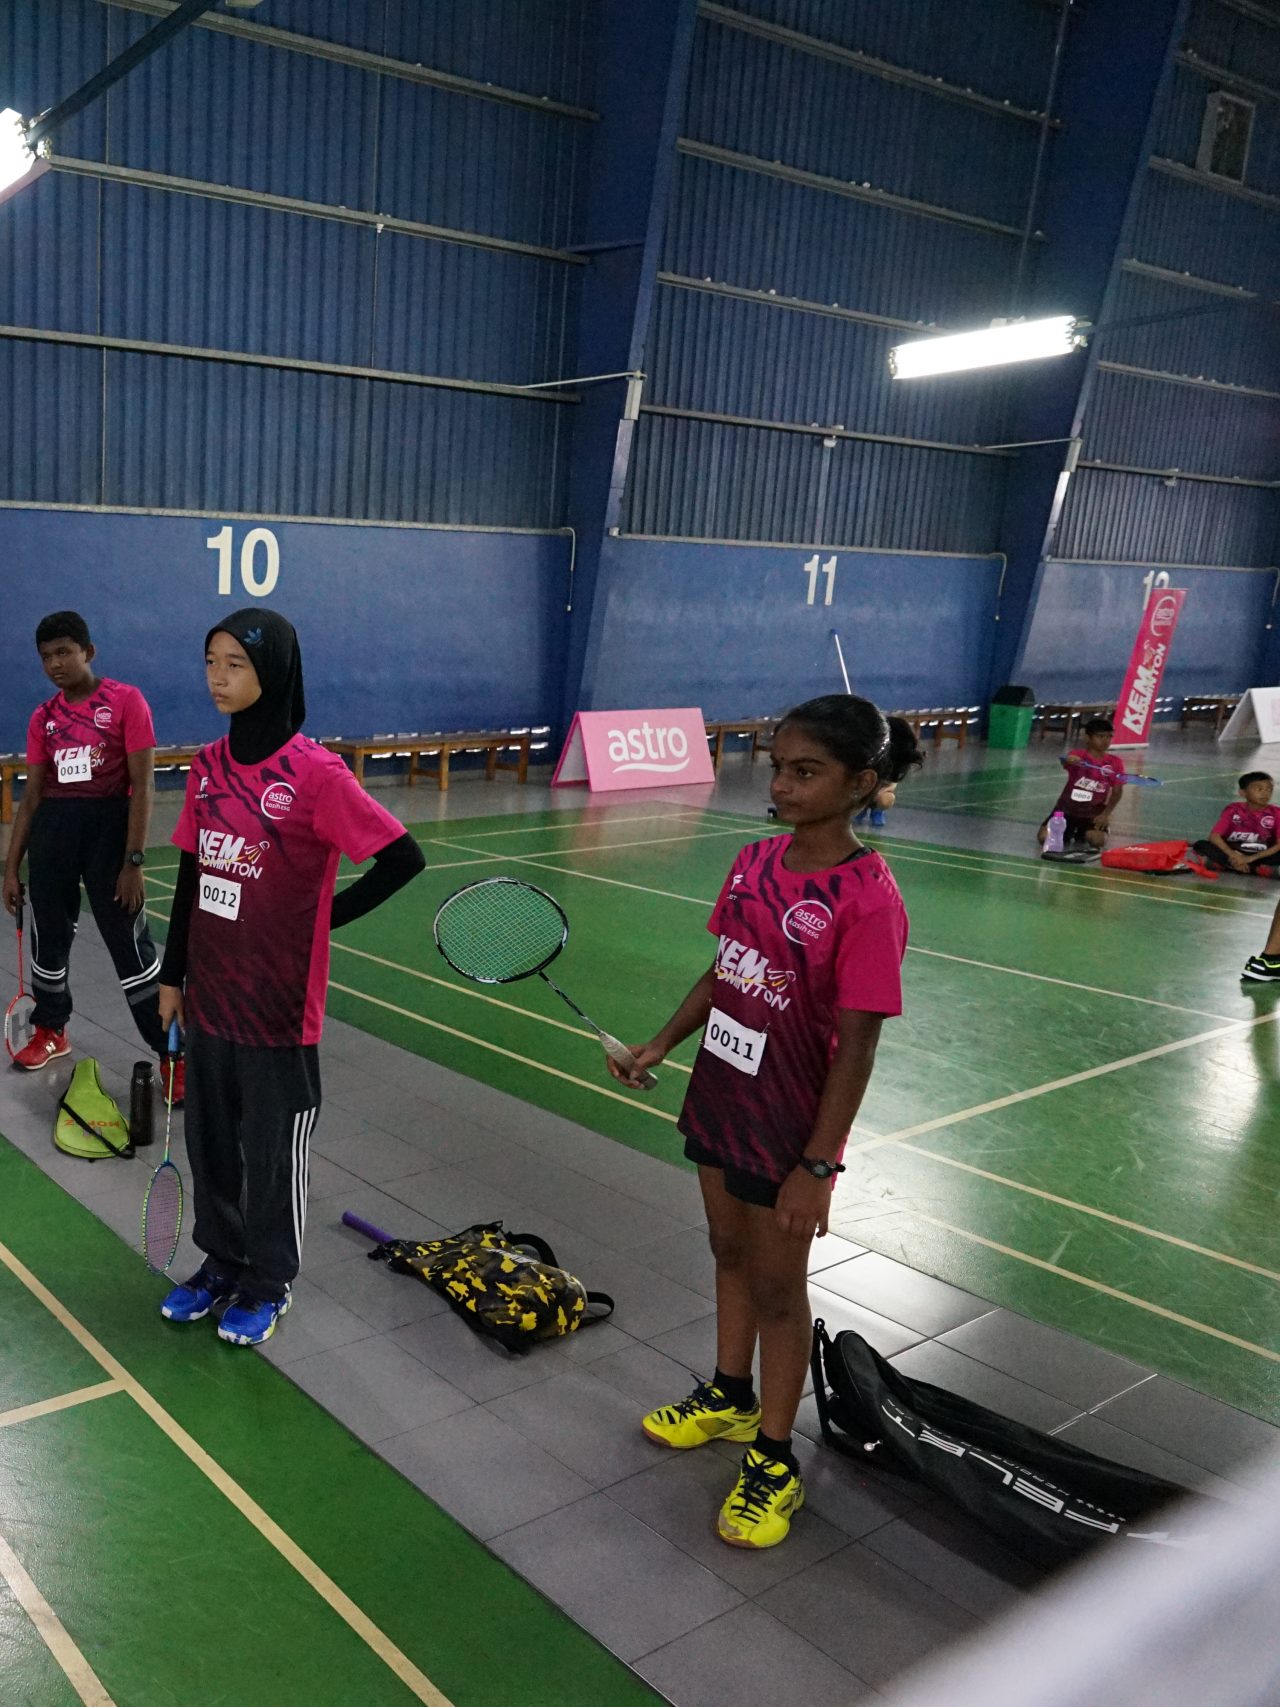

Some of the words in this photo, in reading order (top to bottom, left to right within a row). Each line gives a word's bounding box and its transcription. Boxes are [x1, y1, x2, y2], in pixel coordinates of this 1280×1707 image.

[206, 525, 280, 598] 10
[803, 554, 838, 606] 11
[1121, 663, 1152, 733] KEM
[53, 744, 92, 764] KEM
[607, 721, 688, 763] astro
[60, 764, 88, 777] 0013
[268, 790, 293, 803] astro
[199, 828, 246, 862] KEM
[203, 884, 237, 908] 0012
[794, 907, 827, 930] astro
[716, 934, 769, 984] KEM
[710, 1023, 755, 1061] 0011
